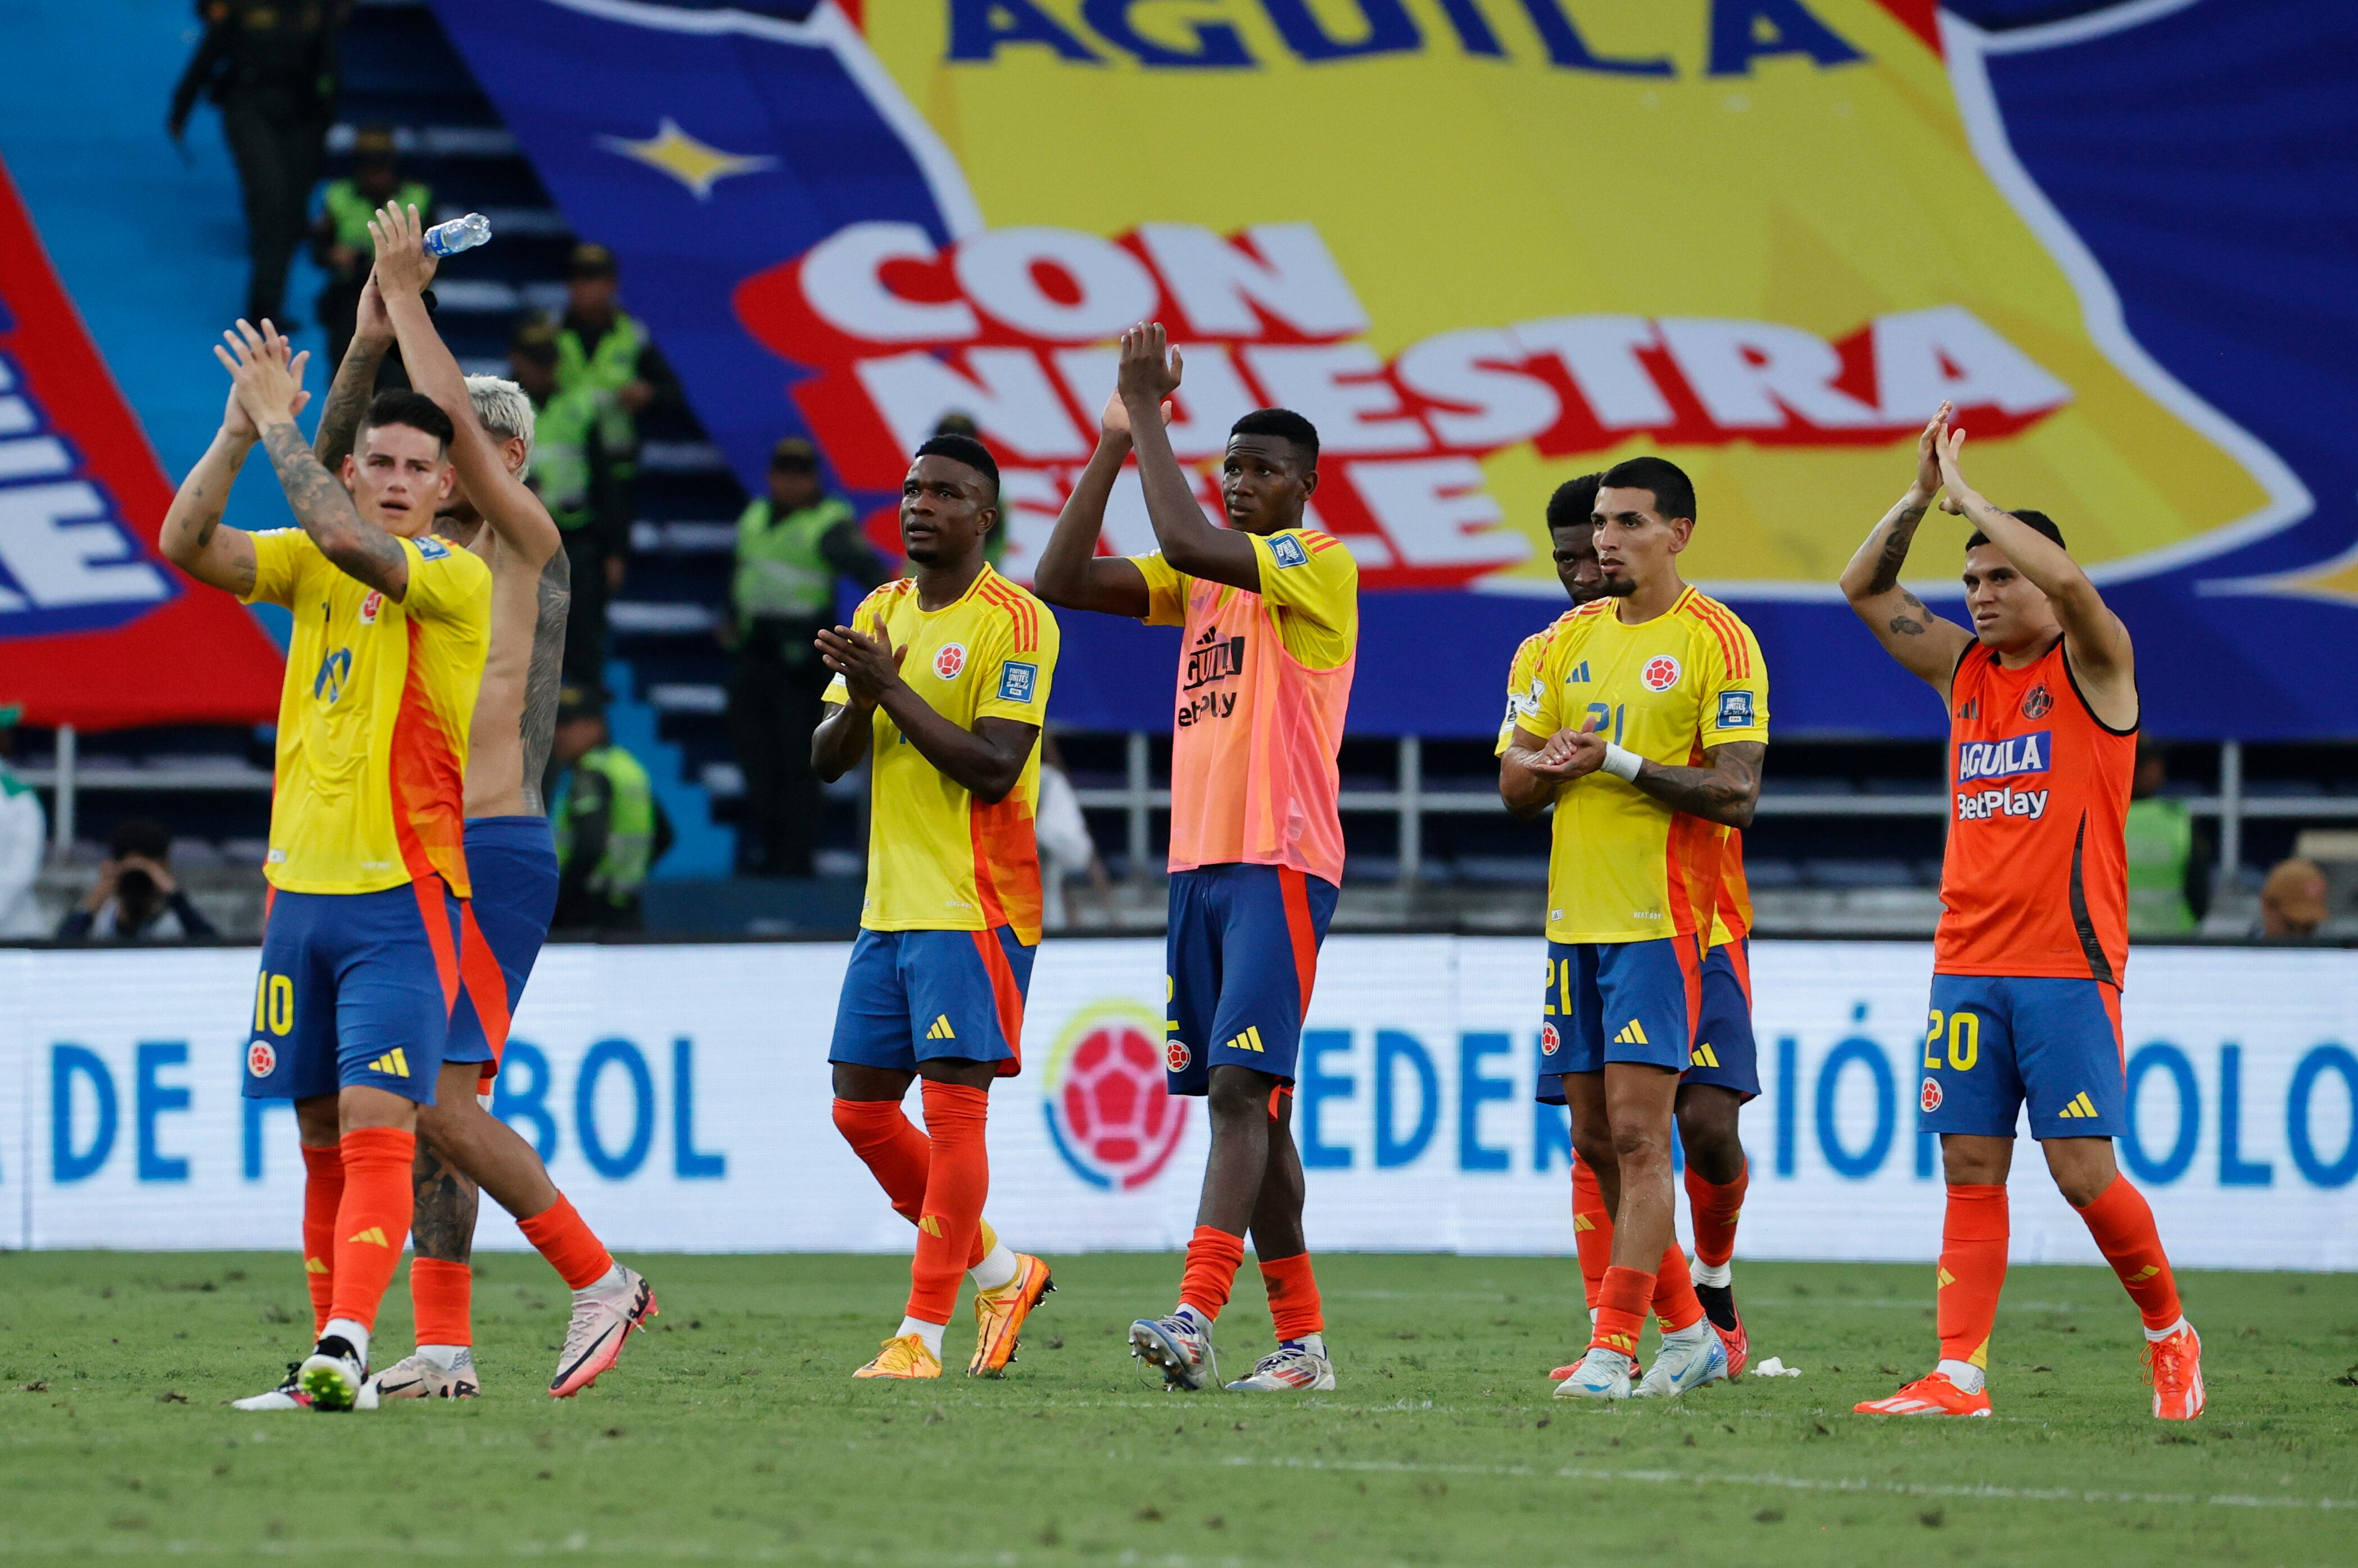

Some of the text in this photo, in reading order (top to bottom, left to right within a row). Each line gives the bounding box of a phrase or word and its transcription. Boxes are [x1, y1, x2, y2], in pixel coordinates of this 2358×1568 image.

[799, 221, 1372, 344] CON
[857, 305, 2074, 456] NUESTRA
[1008, 674, 1029, 683] UNITES
[1010, 668, 1030, 677] FOOTBALL
[1587, 703, 1624, 745] 21
[1957, 786, 2049, 821] BetPlay
[255, 970, 294, 1036] 10
[1544, 958, 1572, 1015] 21
[1924, 1009, 1979, 1071] 20
[52, 1041, 192, 1183] DE
